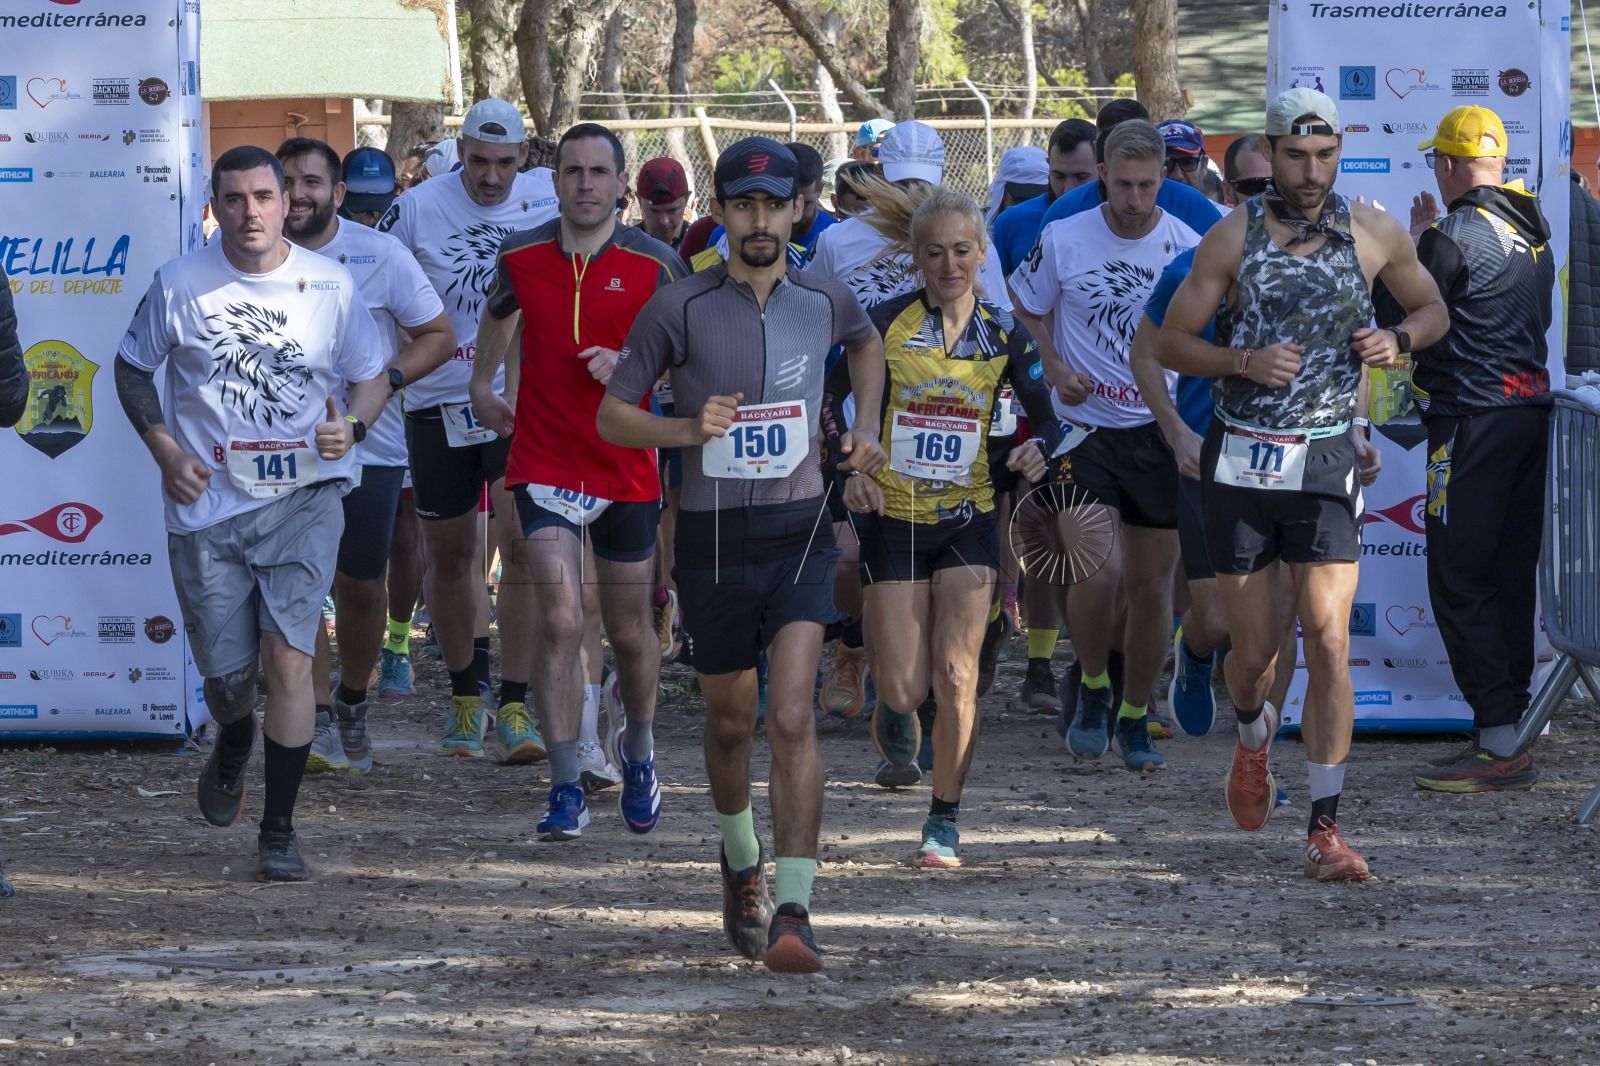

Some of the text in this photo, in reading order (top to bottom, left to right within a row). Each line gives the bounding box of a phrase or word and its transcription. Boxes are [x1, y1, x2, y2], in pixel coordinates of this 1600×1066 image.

[1310, 2, 1507, 18] Trasmediterránea
[1452, 76, 1489, 85] BACKYARD
[93, 85, 129, 94] BACKYARD
[1392, 122, 1427, 132] QUBIKA
[33, 131, 69, 141] QUBIKA
[136, 164, 172, 174] El Rinconcito
[1343, 161, 1387, 170] DECATHLON
[1512, 165, 1528, 174] Lowis
[89, 170, 126, 178] BALEARIA
[143, 174, 168, 183] de Lowis
[29, 279, 57, 295] DEL
[63, 278, 124, 295] DEPORTE
[310, 283, 341, 291] MELILLA
[741, 409, 791, 420] BACKYARD
[925, 419, 968, 430] BACKYARD
[728, 423, 787, 459] 150
[913, 431, 962, 463] 169
[1249, 441, 1285, 473] 171
[252, 452, 297, 481] 141
[0, 550, 152, 566] mediterránea
[98, 623, 135, 632] BACKYARD
[38, 669, 74, 680] QUBIKA
[95, 708, 131, 716] BALEARIA
[142, 703, 178, 711] El Rinconcito
[149, 712, 156, 720] de
